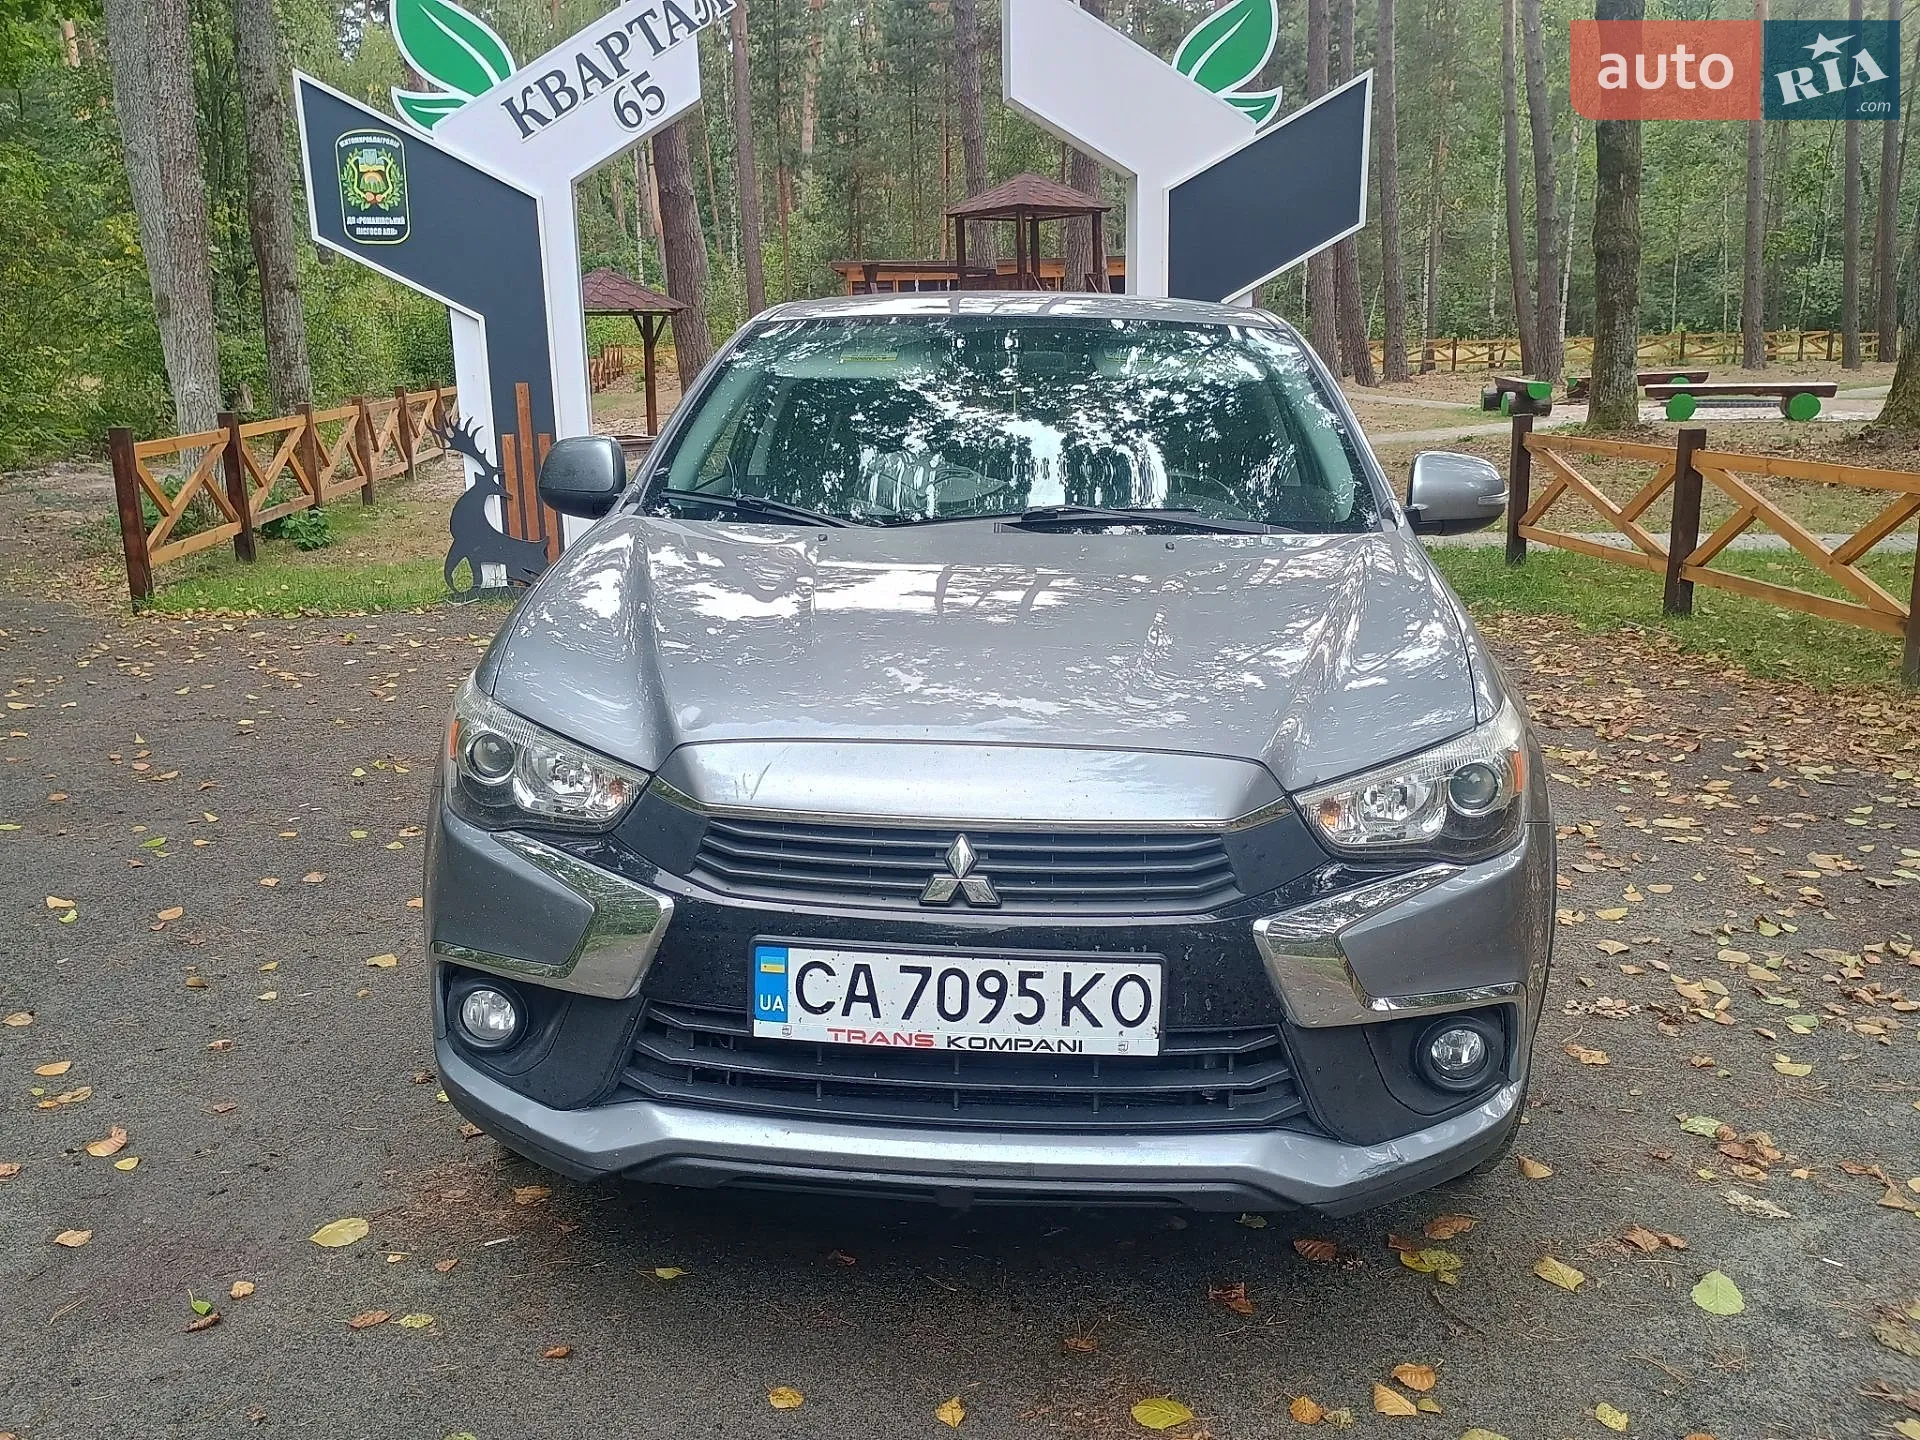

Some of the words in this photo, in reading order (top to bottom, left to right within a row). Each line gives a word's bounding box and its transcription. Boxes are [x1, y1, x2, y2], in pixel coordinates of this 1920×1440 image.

[613, 70, 666, 129] 65
[759, 995, 785, 1012] UA
[827, 1028, 934, 1047] TRANS
[947, 1035, 1084, 1053] KOMPANI
